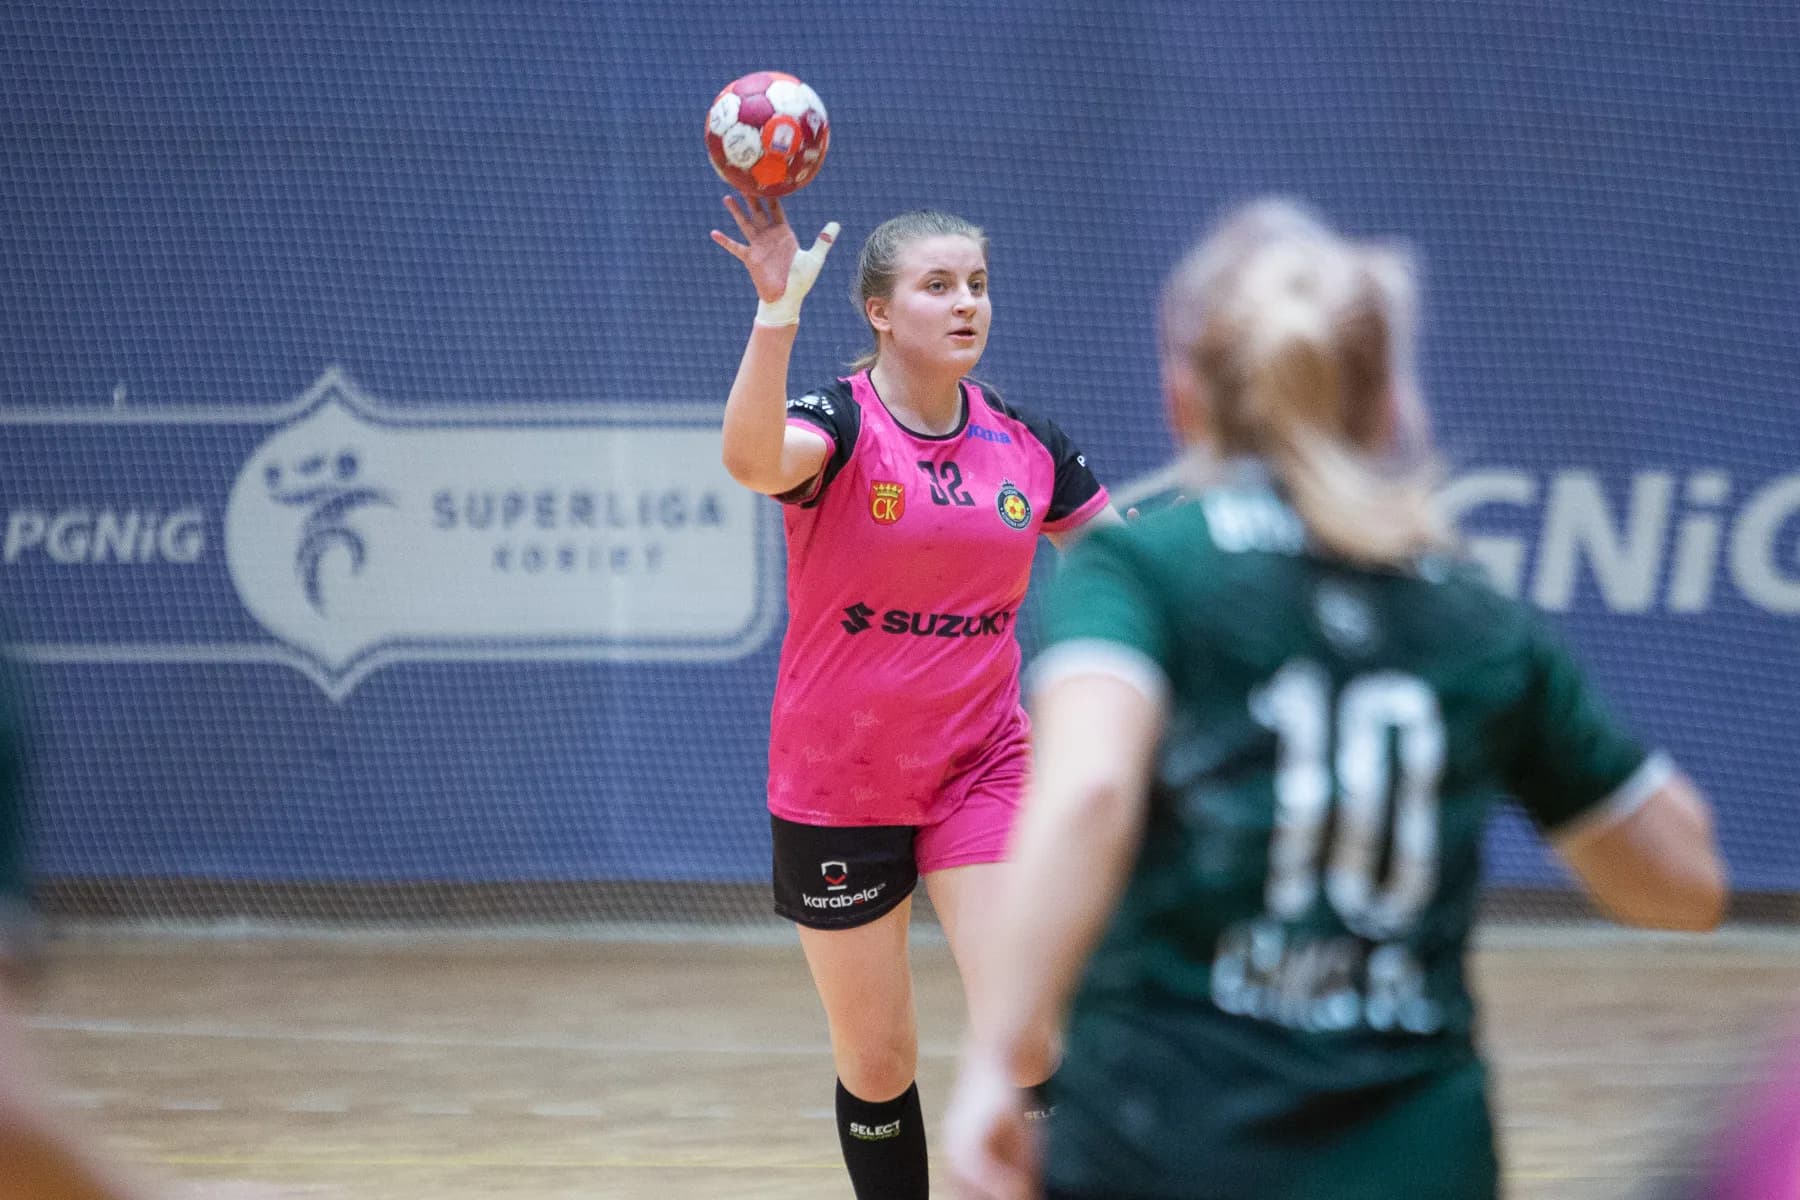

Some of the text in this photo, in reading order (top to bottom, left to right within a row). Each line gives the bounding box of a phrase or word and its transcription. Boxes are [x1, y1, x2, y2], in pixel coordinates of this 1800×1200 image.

[432, 489, 726, 530] SUPERLIGA
[872, 497, 898, 521] CK
[4, 508, 204, 565] PGNiG
[881, 609, 1010, 638] SUZUKI
[1248, 658, 1448, 942] 10
[802, 887, 879, 909] karabela
[850, 1119, 900, 1136] SELECT
